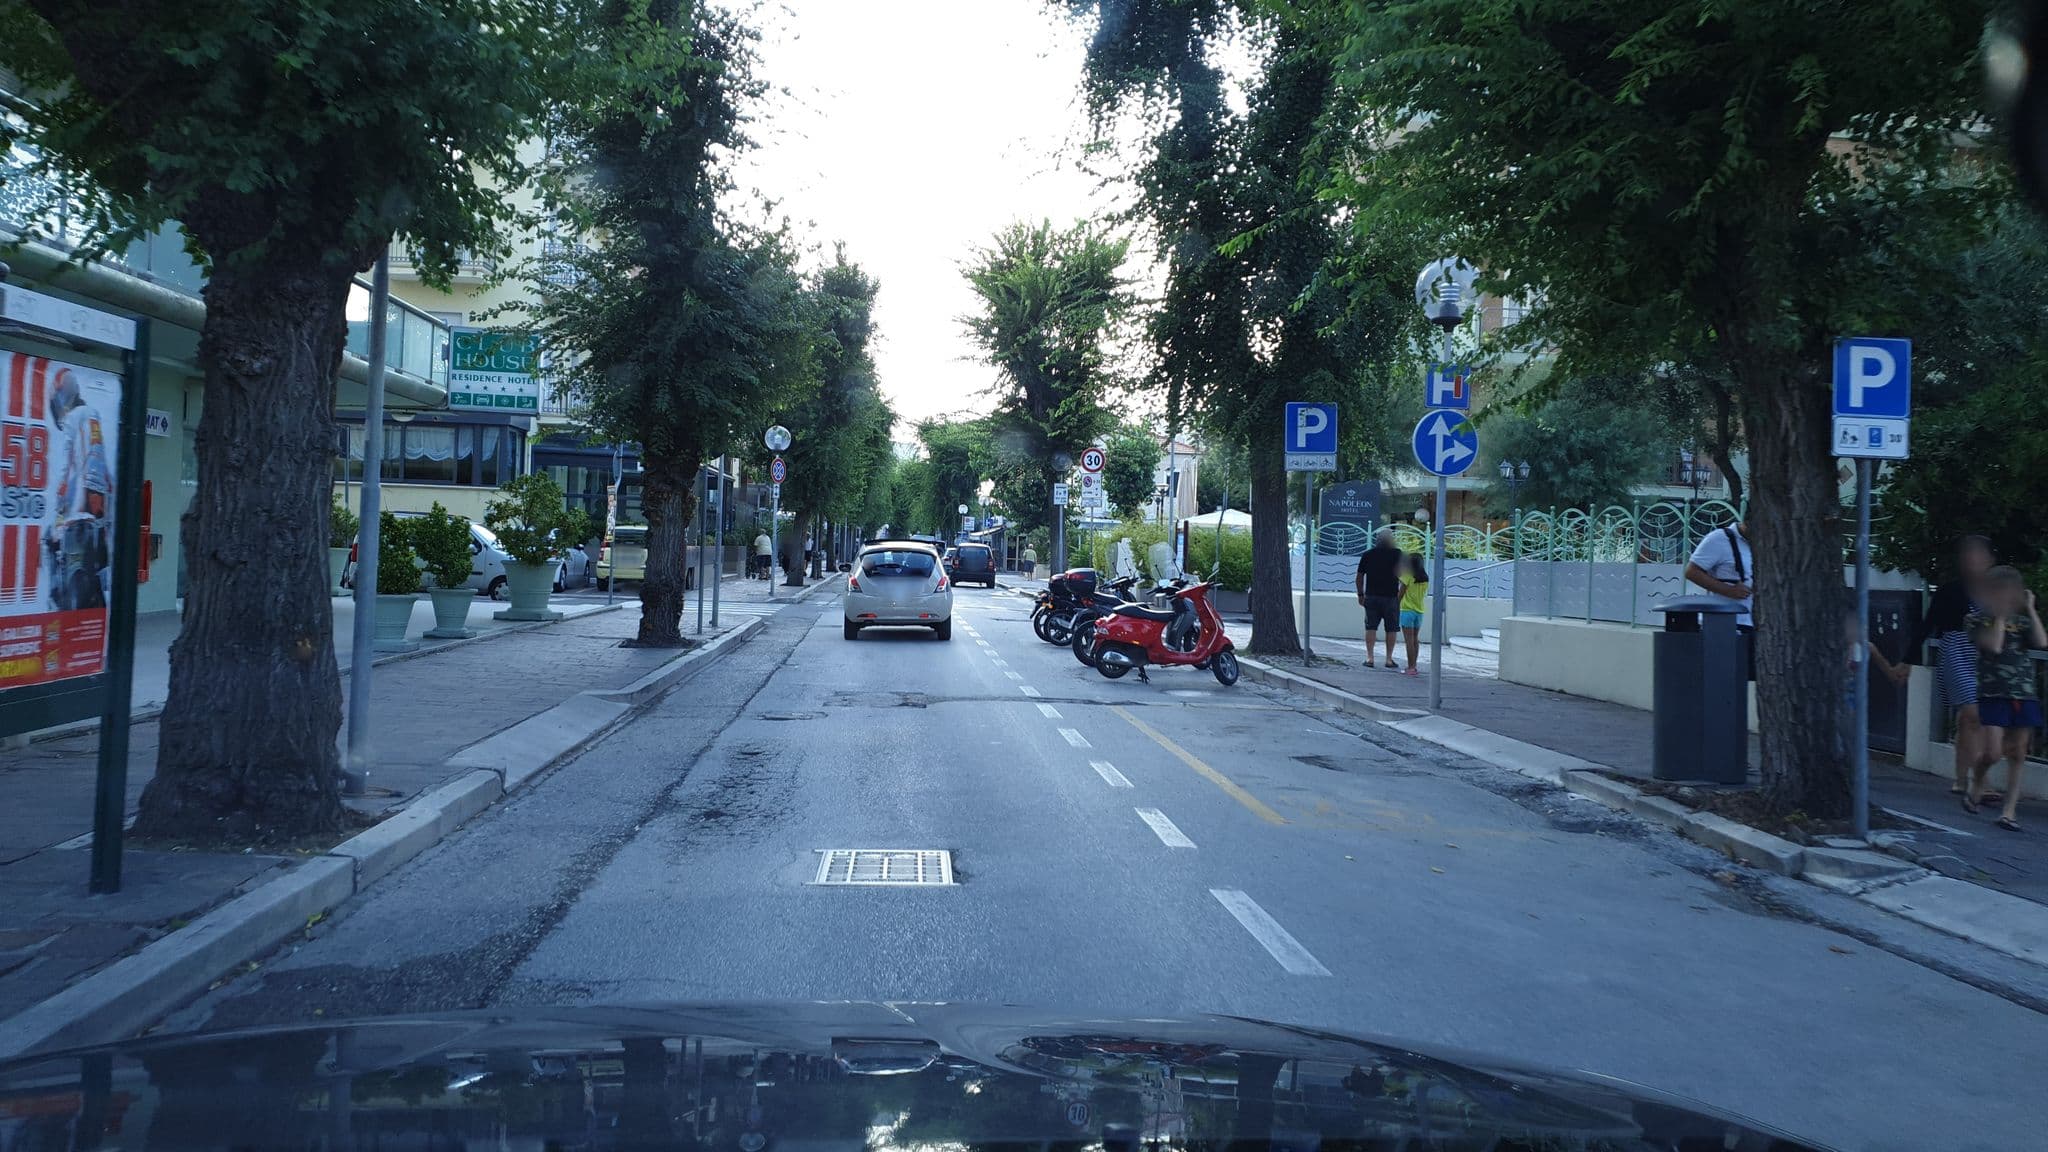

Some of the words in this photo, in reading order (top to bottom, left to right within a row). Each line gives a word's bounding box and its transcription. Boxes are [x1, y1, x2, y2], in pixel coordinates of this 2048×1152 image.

[452, 373, 502, 383] RESIDENCE
[507, 376, 536, 385] HOTEL
[1849, 346, 1896, 407] P
[1297, 408, 1327, 447] P
[1, 422, 48, 489] 58
[1086, 455, 1100, 466] 30
[1328, 499, 1373, 508] NAPOLEON
